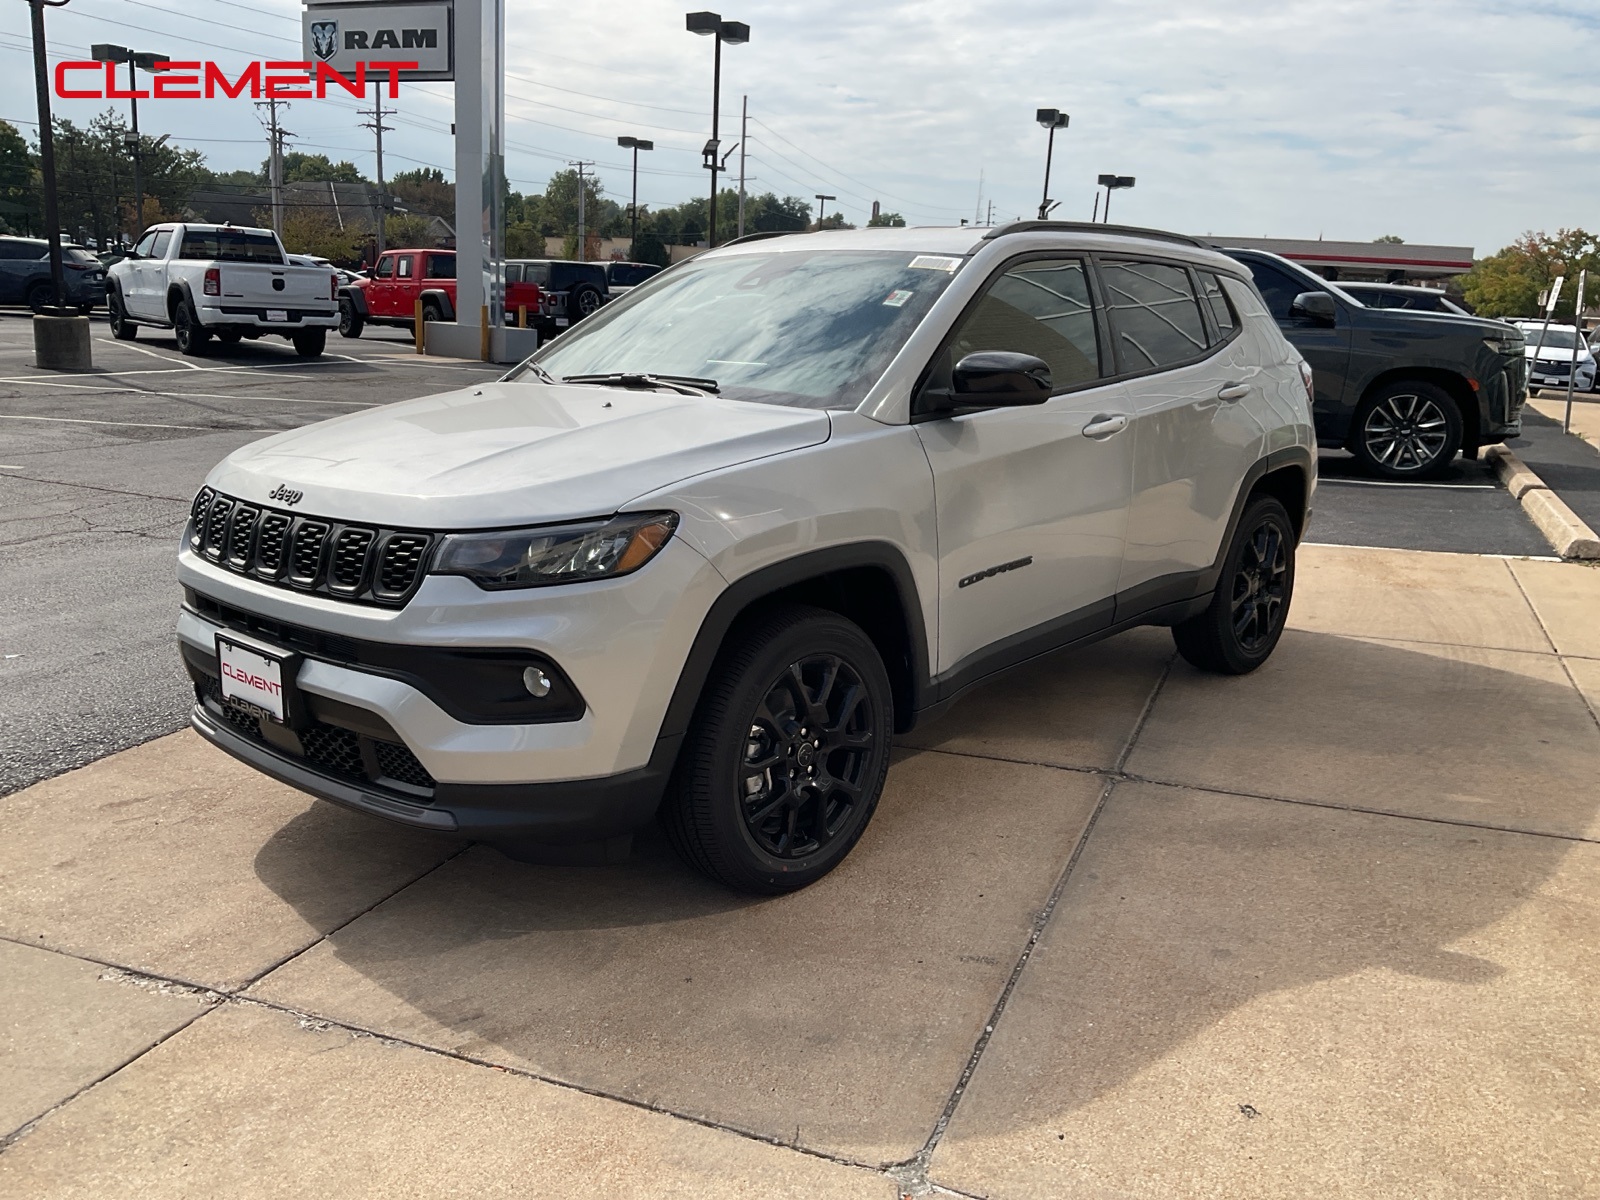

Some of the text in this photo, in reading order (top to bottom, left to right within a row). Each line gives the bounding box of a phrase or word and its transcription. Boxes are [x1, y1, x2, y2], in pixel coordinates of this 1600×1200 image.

[344, 29, 437, 49] RAM
[269, 484, 304, 506] Jeep
[223, 663, 281, 696] CLEMENT
[230, 696, 271, 721] CLEMENT
